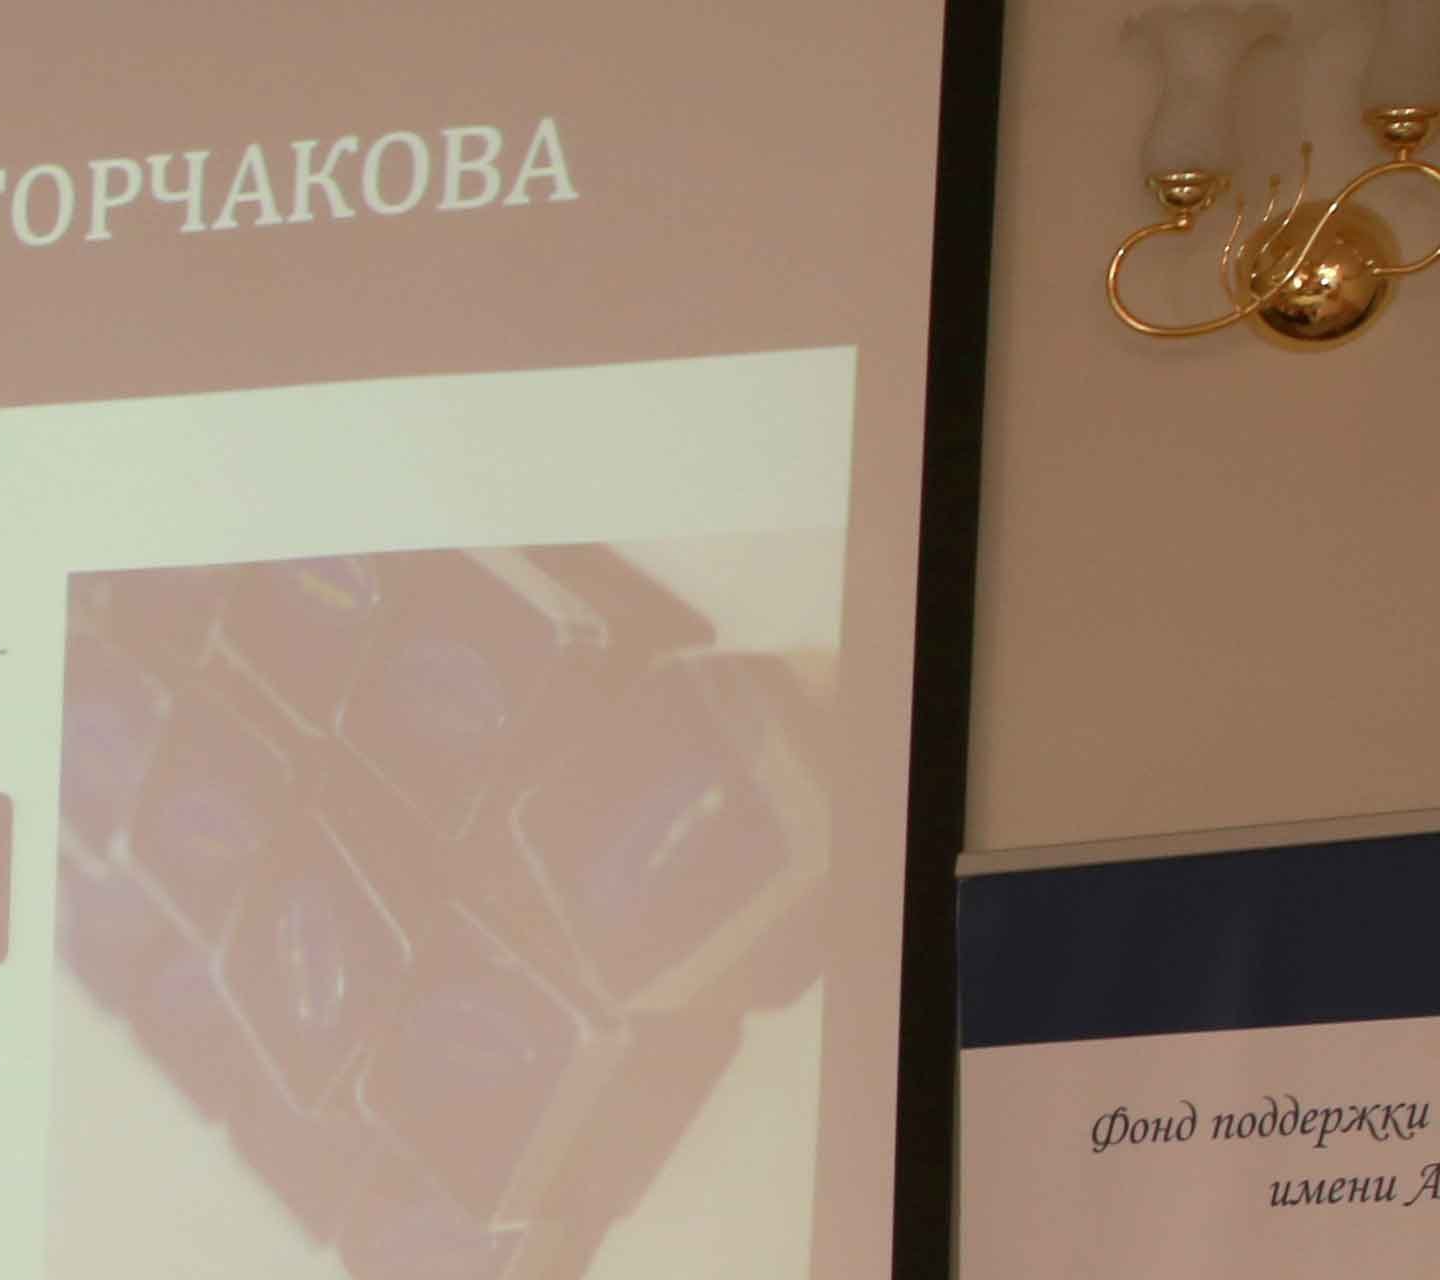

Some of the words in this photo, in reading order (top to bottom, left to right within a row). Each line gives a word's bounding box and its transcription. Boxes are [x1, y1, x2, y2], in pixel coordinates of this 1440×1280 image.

[1090, 1098, 1199, 1154] Фонд
[1210, 1093, 1431, 1150] поддержки
[1268, 1174, 1398, 1208] имени
